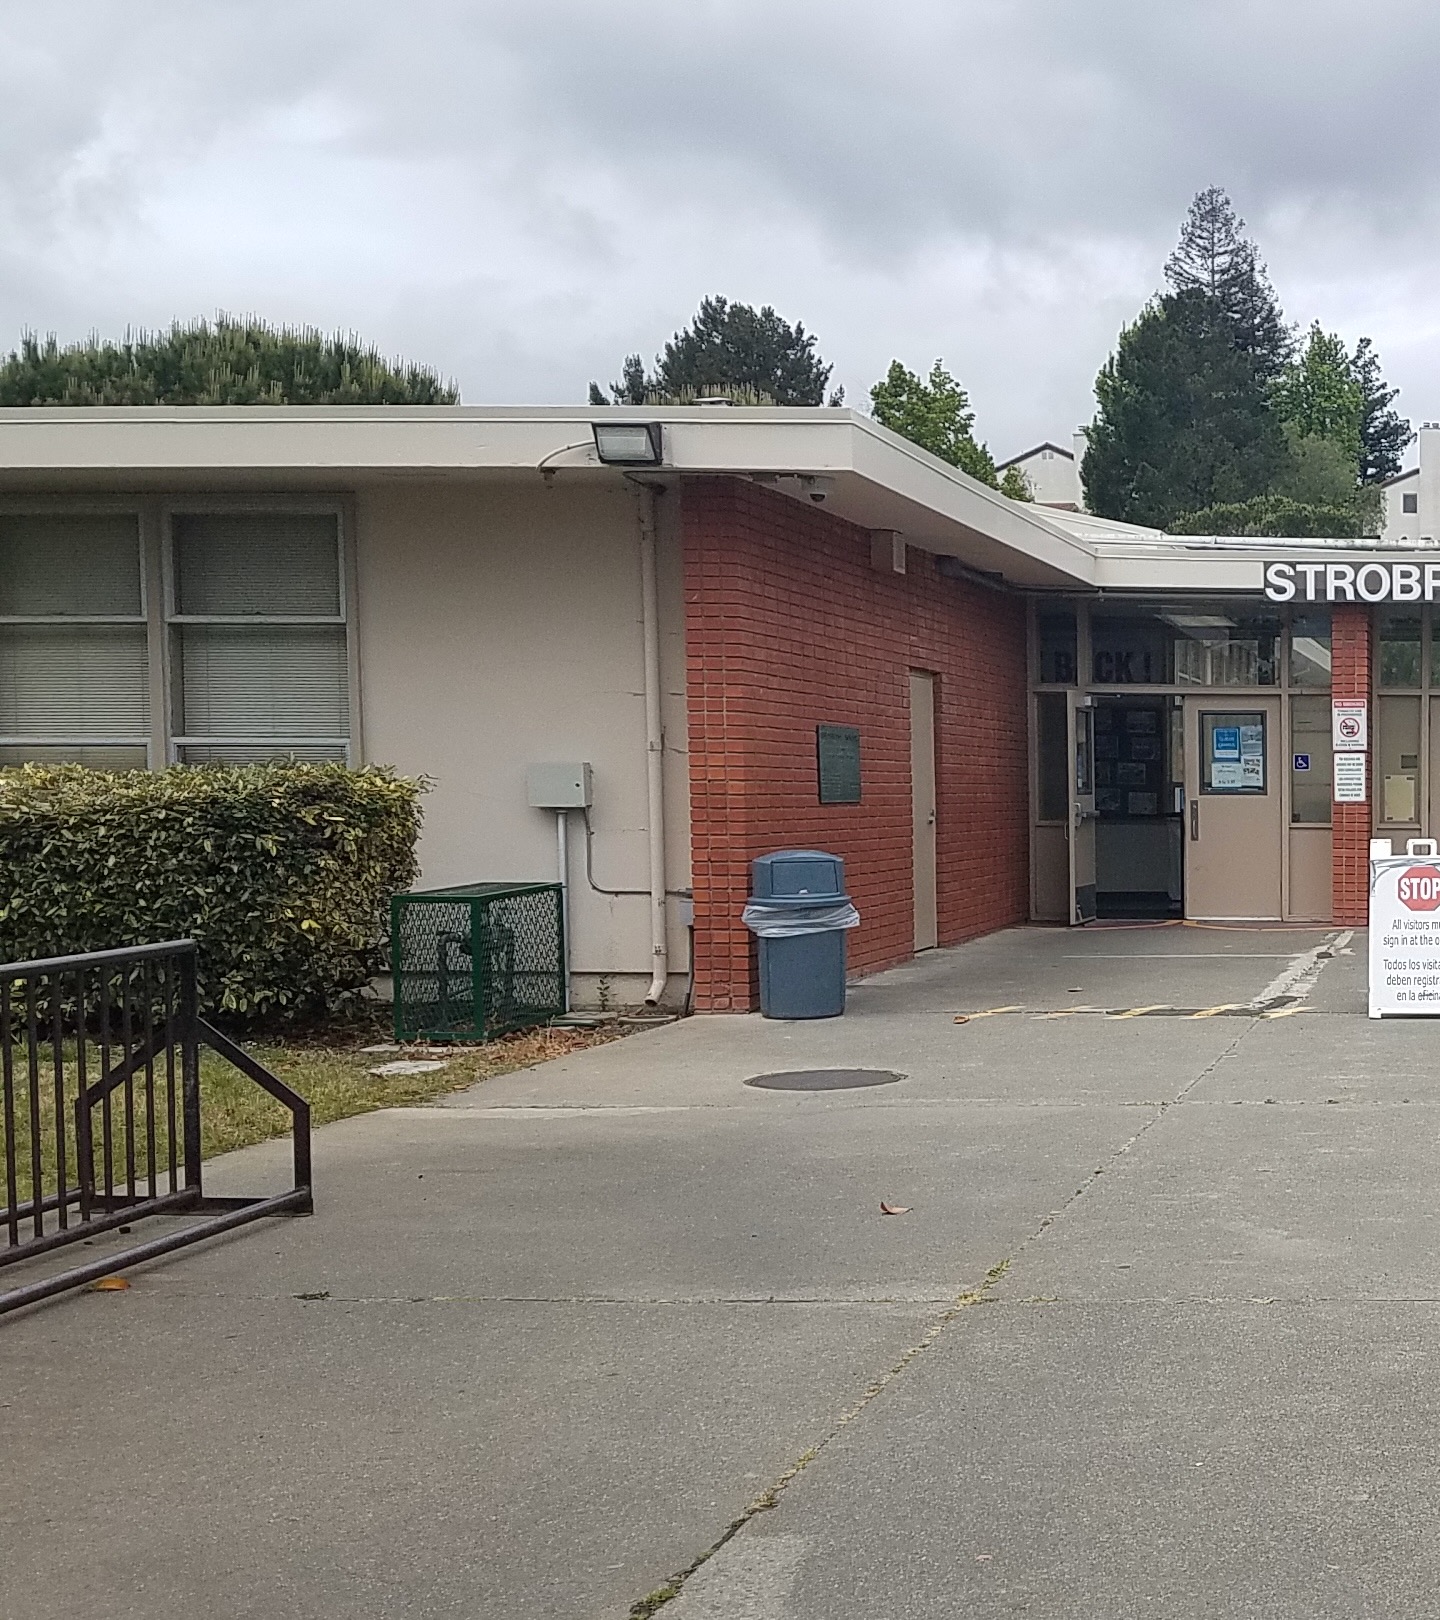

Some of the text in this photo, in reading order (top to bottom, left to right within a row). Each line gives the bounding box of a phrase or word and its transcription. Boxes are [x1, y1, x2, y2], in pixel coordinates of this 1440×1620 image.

[1392, 919, 1402, 930] All
[1403, 919, 1430, 930] visitors
[1383, 935, 1399, 948] sign
[1401, 935, 1408, 946] in
[1409, 935, 1418, 946] at
[1419, 934, 1433, 946] the
[1383, 959, 1407, 970] Todos
[1408, 959, 1421, 970] los
[1386, 974, 1412, 986] deben
[1396, 991, 1407, 1001] en
[1408, 990, 1416, 1001] la
